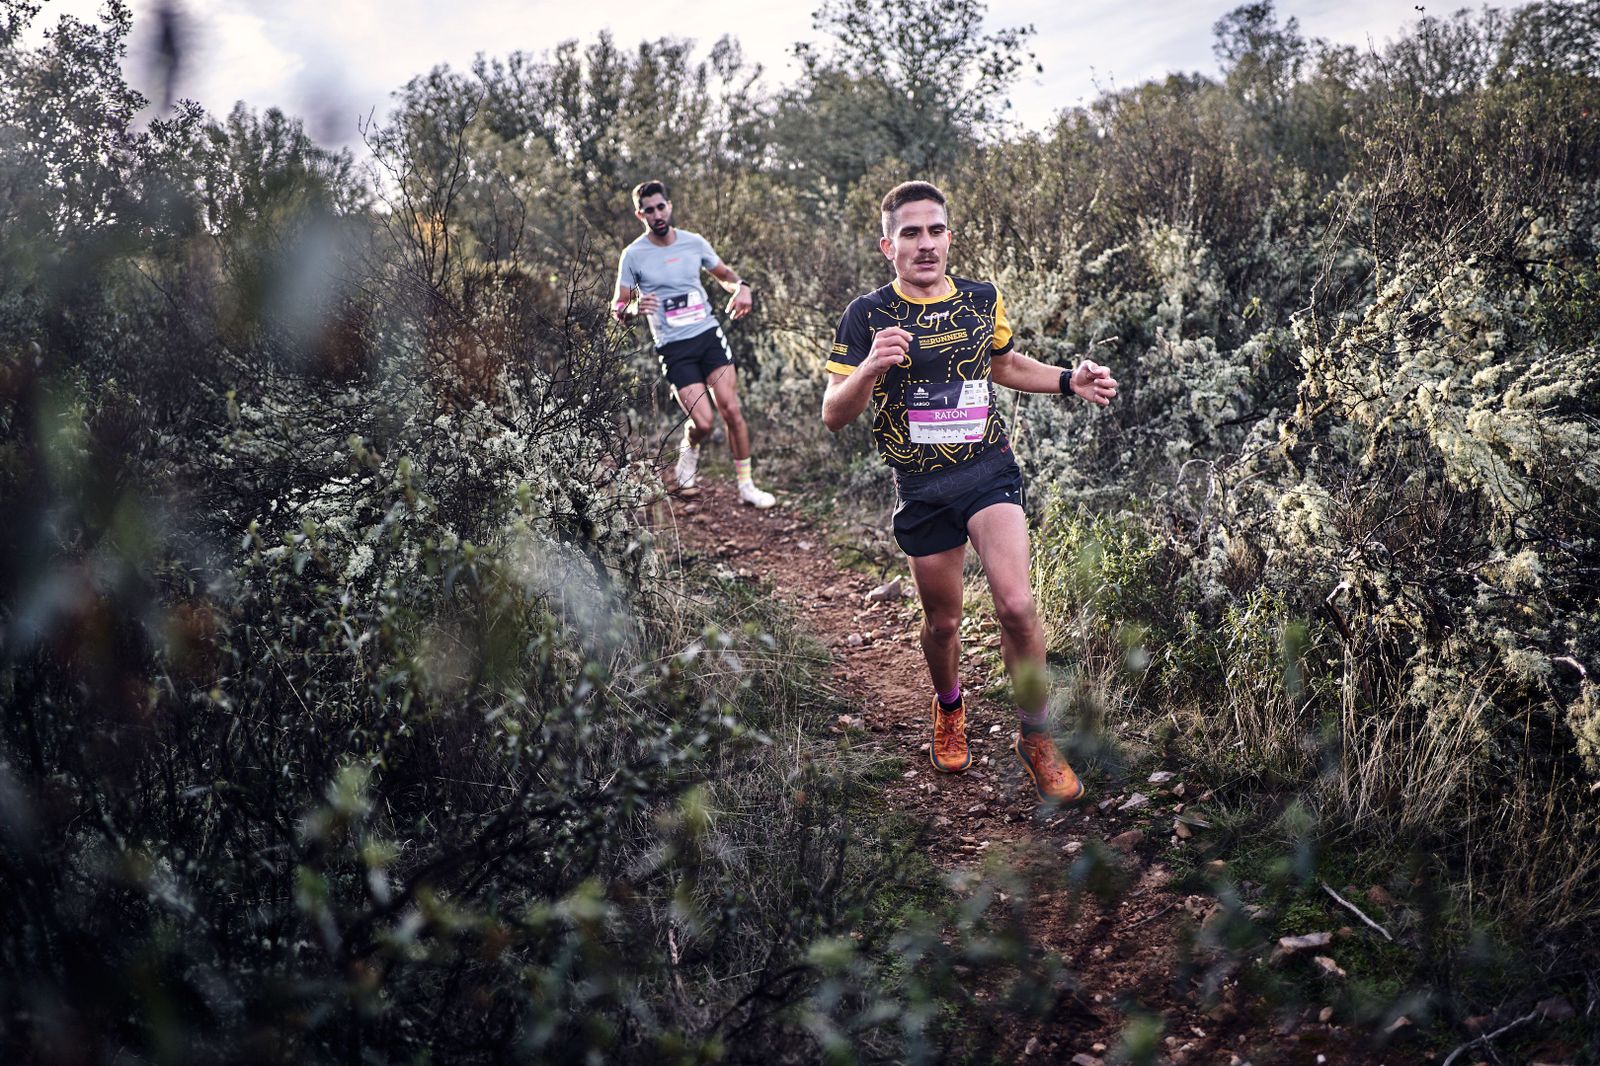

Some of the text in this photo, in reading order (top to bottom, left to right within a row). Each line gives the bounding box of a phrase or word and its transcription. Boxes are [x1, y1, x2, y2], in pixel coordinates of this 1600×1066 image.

[930, 331, 968, 345] RUNNERS
[943, 396, 948, 405] 1
[934, 408, 968, 420] RATÓN
